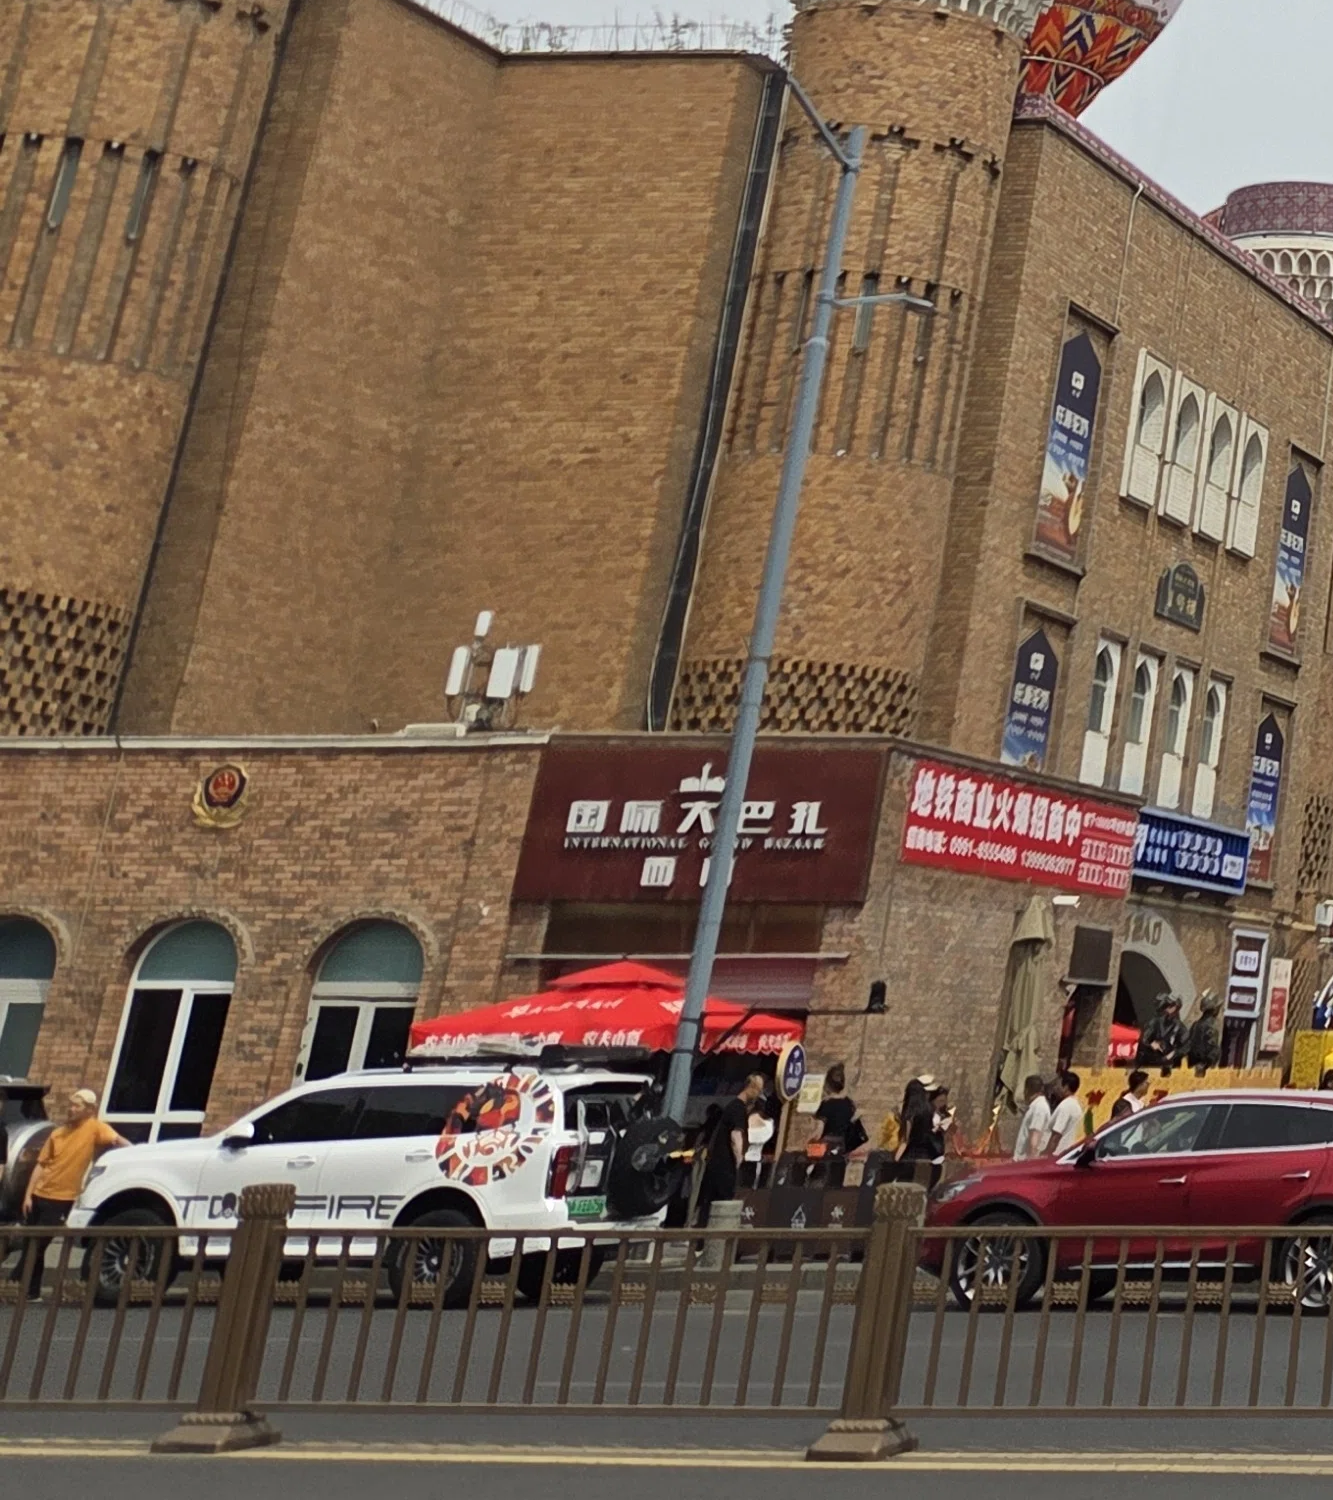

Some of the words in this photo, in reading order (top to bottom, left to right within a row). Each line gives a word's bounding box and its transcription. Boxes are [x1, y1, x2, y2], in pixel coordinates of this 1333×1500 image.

[566, 800, 828, 834] 国际大巴扎
